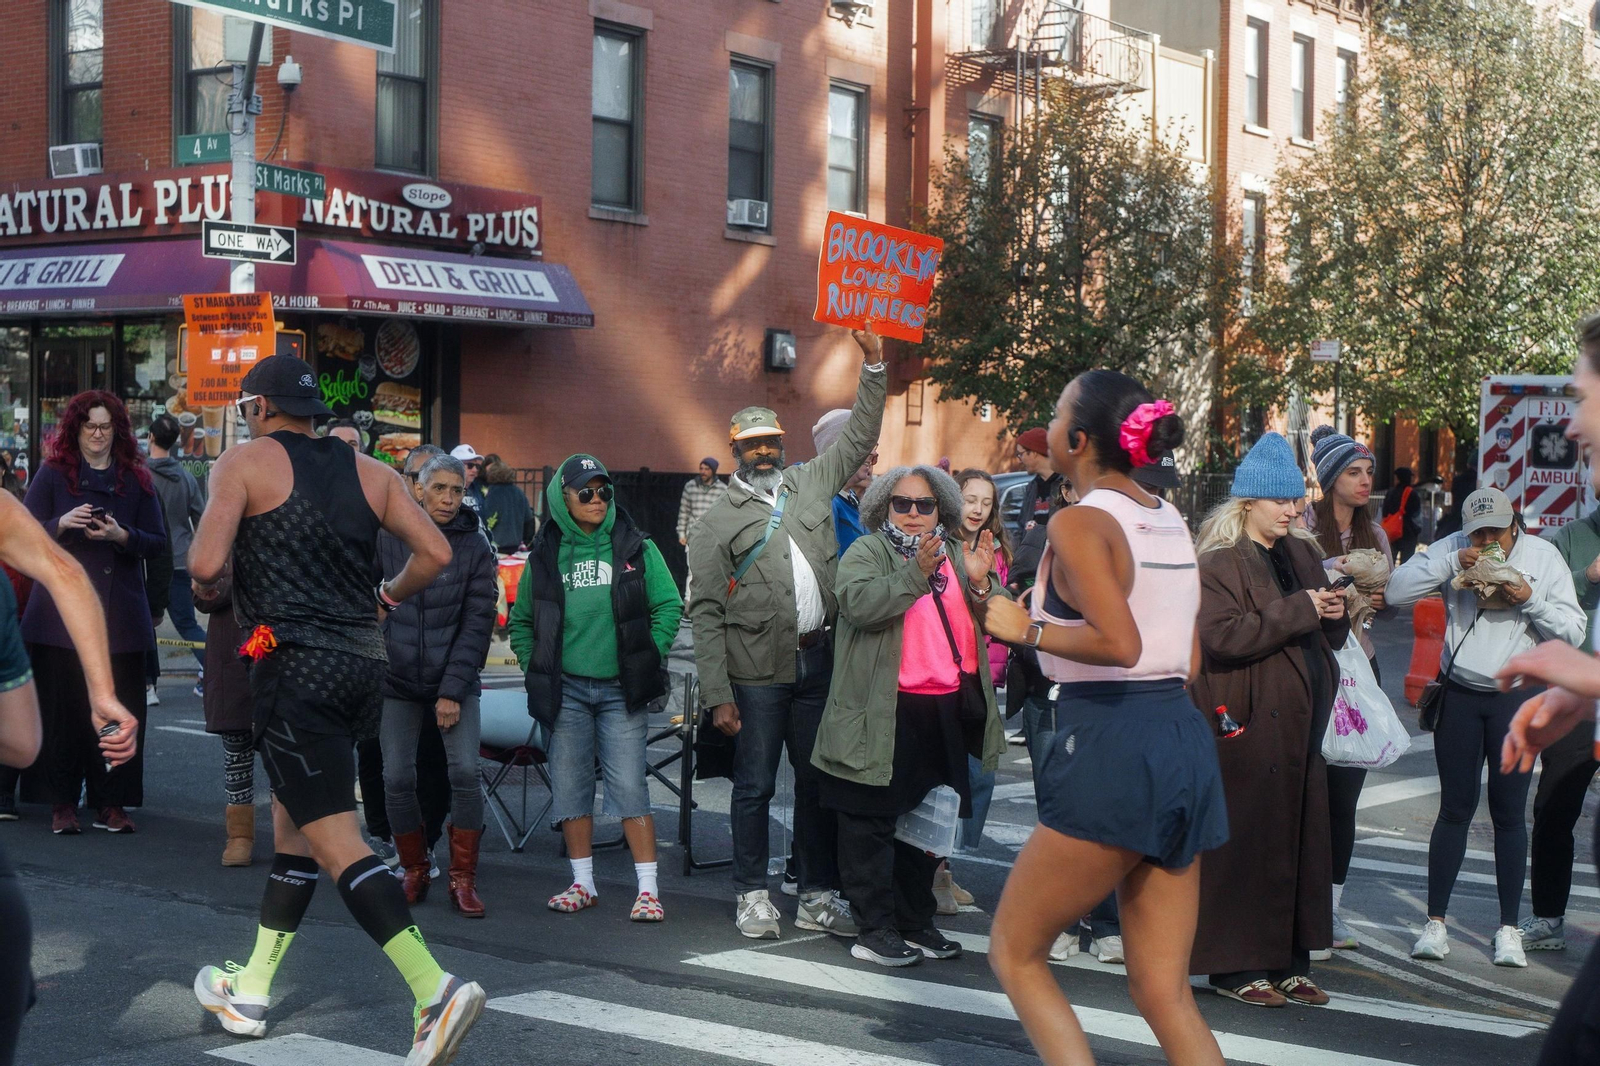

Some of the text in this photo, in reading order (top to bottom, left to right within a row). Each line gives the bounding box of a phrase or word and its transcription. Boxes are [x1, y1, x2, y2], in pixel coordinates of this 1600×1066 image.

[241, 0, 329, 22] rks
[338, 1, 363, 30] Pl
[193, 138, 218, 158] 4 Av
[256, 169, 323, 195] St Marks Pl
[408, 188, 447, 203] Slope
[0, 175, 233, 236] ATURAL PLU
[302, 188, 539, 248] NATURAL PLUS
[218, 233, 282, 251] ONE WAY
[827, 222, 940, 282] BROOKLYN
[14, 262, 36, 284] &
[37, 258, 104, 284] GRILL
[378, 260, 545, 297] DELI & GRILL
[841, 265, 900, 293] LOVES
[7, 298, 96, 312] BREAKFAST LUNCH DINNER
[193, 297, 204, 308] ST
[206, 296, 236, 308] MARKS
[236, 295, 262, 307] PLACE
[273, 296, 287, 307] 24
[352, 299, 361, 309] 77
[826, 282, 926, 328] RUNNERS
[191, 313, 220, 322] Between
[397, 301, 417, 314] JUICE
[424, 303, 446, 315] SALAD
[452, 305, 489, 318] BREAKFAST
[495, 308, 518, 321] LUNCH
[524, 311, 548, 324] DINNER
[199, 324, 218, 335] WILL
[232, 322, 263, 334] CLOSED
[221, 364, 241, 373] FROM
[200, 378, 215, 388] 7:00
[216, 378, 227, 387] AM
[319, 368, 368, 406] Salad
[193, 391, 206, 401] USE
[1470, 497, 1495, 509] ACADIA
[574, 559, 597, 572] THE
